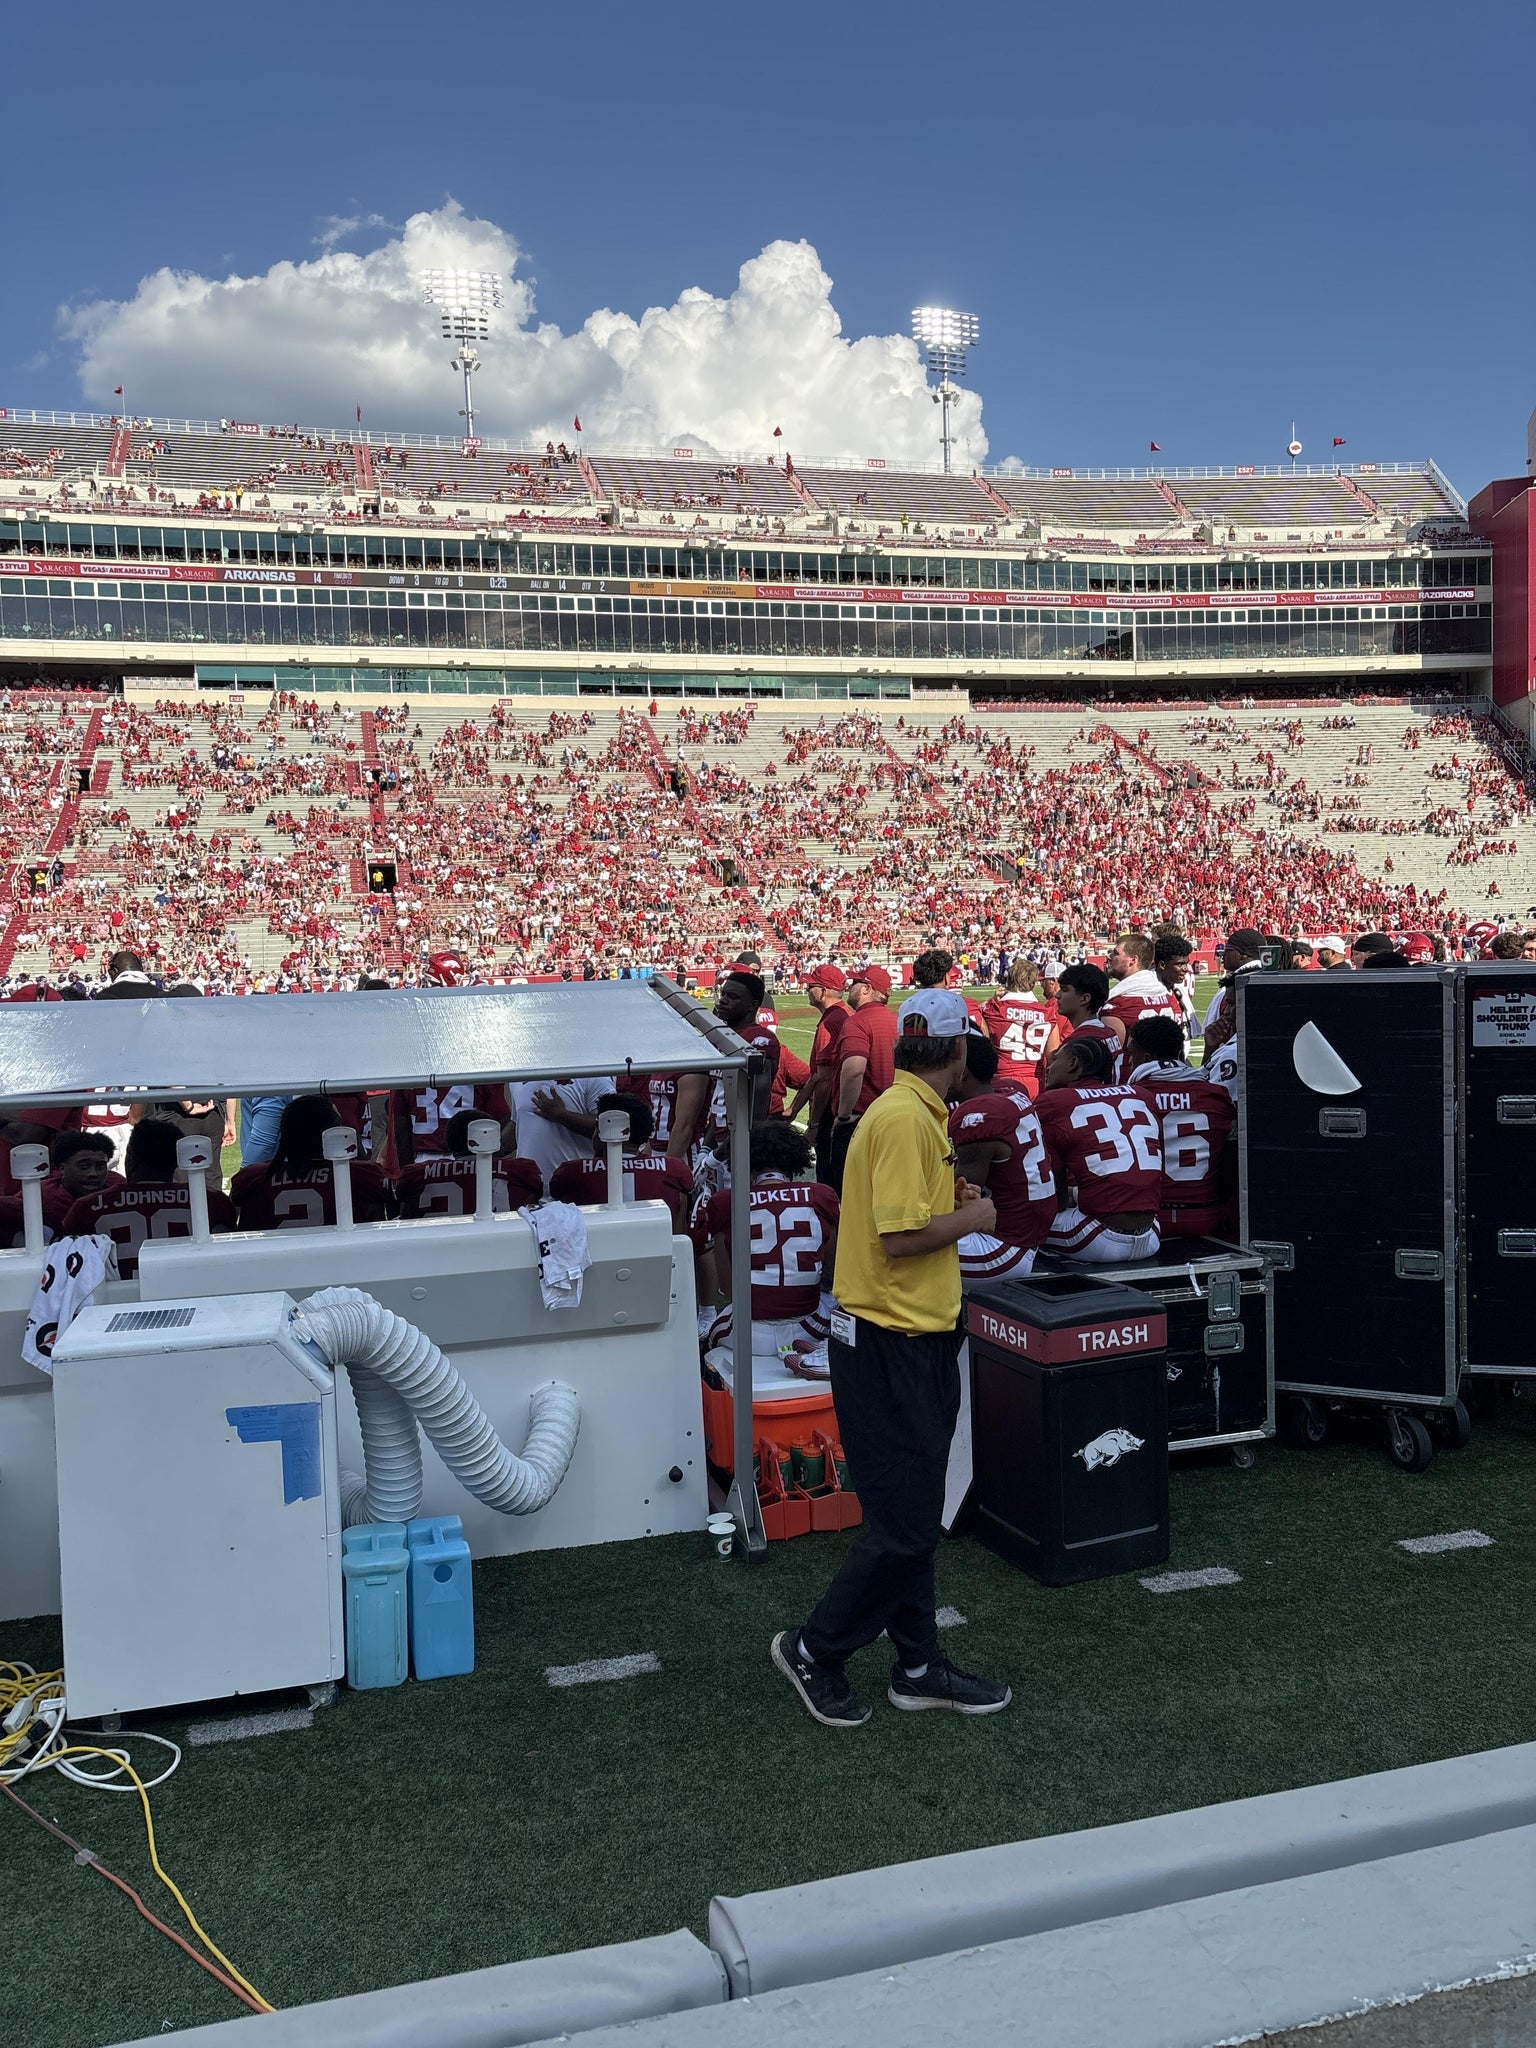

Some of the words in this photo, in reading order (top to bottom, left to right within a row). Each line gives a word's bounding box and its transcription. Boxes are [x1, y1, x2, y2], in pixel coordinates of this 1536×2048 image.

[237, 424, 258, 433] E522
[463, 438, 481, 446] E523
[109, 567, 146, 575] ARKANSAS
[223, 569, 296, 582] ARKANSAS
[313, 572, 322, 585] 14
[414, 575, 420, 586] 3
[489, 577, 508, 589] 0:25
[558, 579, 567, 591] 14
[600, 581, 605, 592] 2
[1418, 590, 1474, 599] RAZORBACKS
[1420, 950, 1432, 962] 59
[1506, 992, 1520, 1000] 13
[1006, 1007, 1045, 1023] SCRIBER
[1489, 1005, 1529, 1014] HELMET
[1476, 1014, 1529, 1023] SHOULDER
[1495, 1022, 1531, 1031] TRUNK
[999, 1021, 1052, 1061] 49
[1074, 1084, 1137, 1100] WOODEN
[411, 1086, 474, 1134] 34
[1069, 1098, 1162, 1177] 32
[1162, 1110, 1211, 1182] 6
[424, 1159, 508, 1180] MITCHL
[582, 1157, 667, 1174] HARISON
[271, 1167, 330, 1187] LEIS
[91, 1194, 108, 1211] J.
[113, 1188, 190, 1208] JOHNSO
[749, 1186, 811, 1206] OCKETT
[750, 1206, 823, 1286] 22
[981, 1313, 1028, 1350] TRASH
[1077, 1323, 1148, 1352] TRASH
